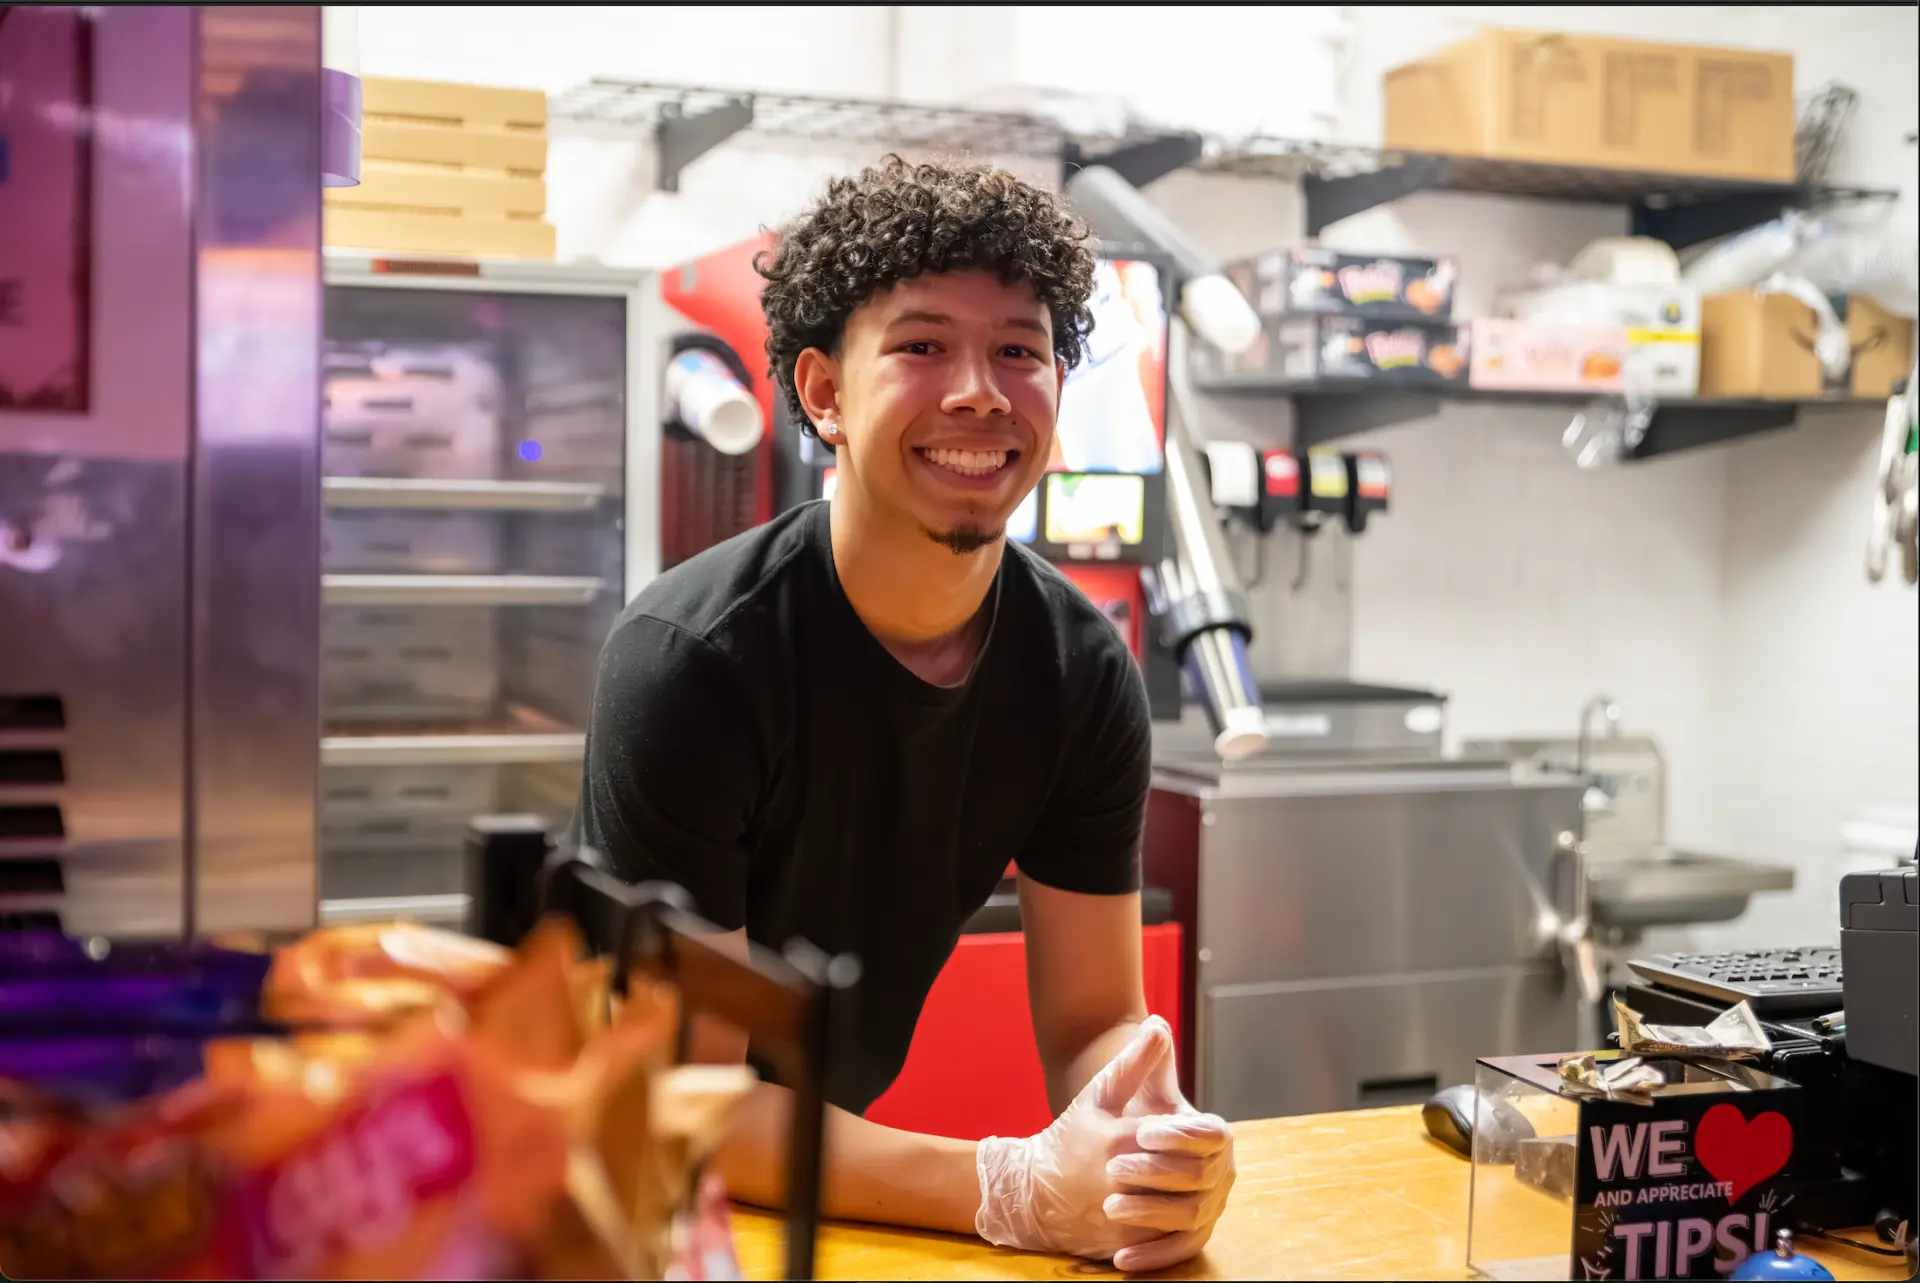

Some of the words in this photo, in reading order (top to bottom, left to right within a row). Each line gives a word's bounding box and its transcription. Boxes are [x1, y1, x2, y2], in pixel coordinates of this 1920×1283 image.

[1589, 1120, 1688, 1181] WE
[1594, 1189, 1632, 1207] AND
[1636, 1181, 1734, 1204] APPRECIATE
[1613, 1212, 1770, 1281] TIPS!
